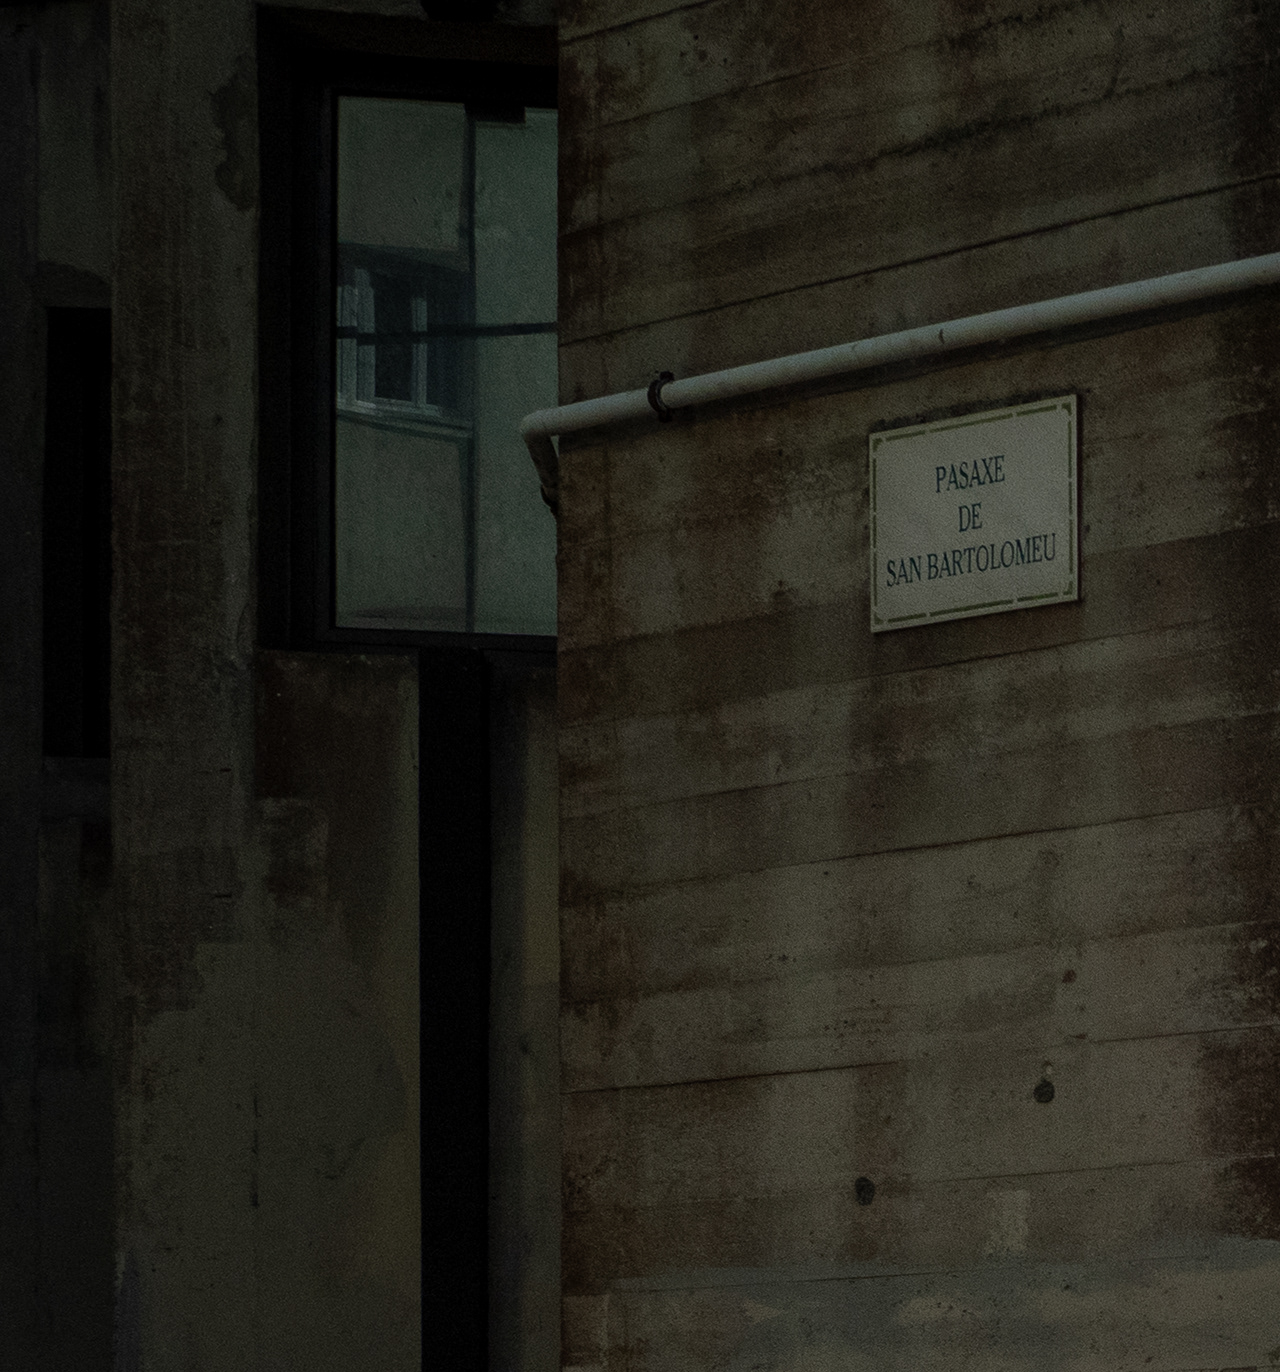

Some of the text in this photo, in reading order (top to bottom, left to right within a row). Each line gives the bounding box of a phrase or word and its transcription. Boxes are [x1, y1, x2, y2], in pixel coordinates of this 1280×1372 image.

[936, 455, 1005, 493] PASAXE
[958, 502, 983, 532] DE
[886, 533, 1056, 587] SAN BARTOLOMEU
